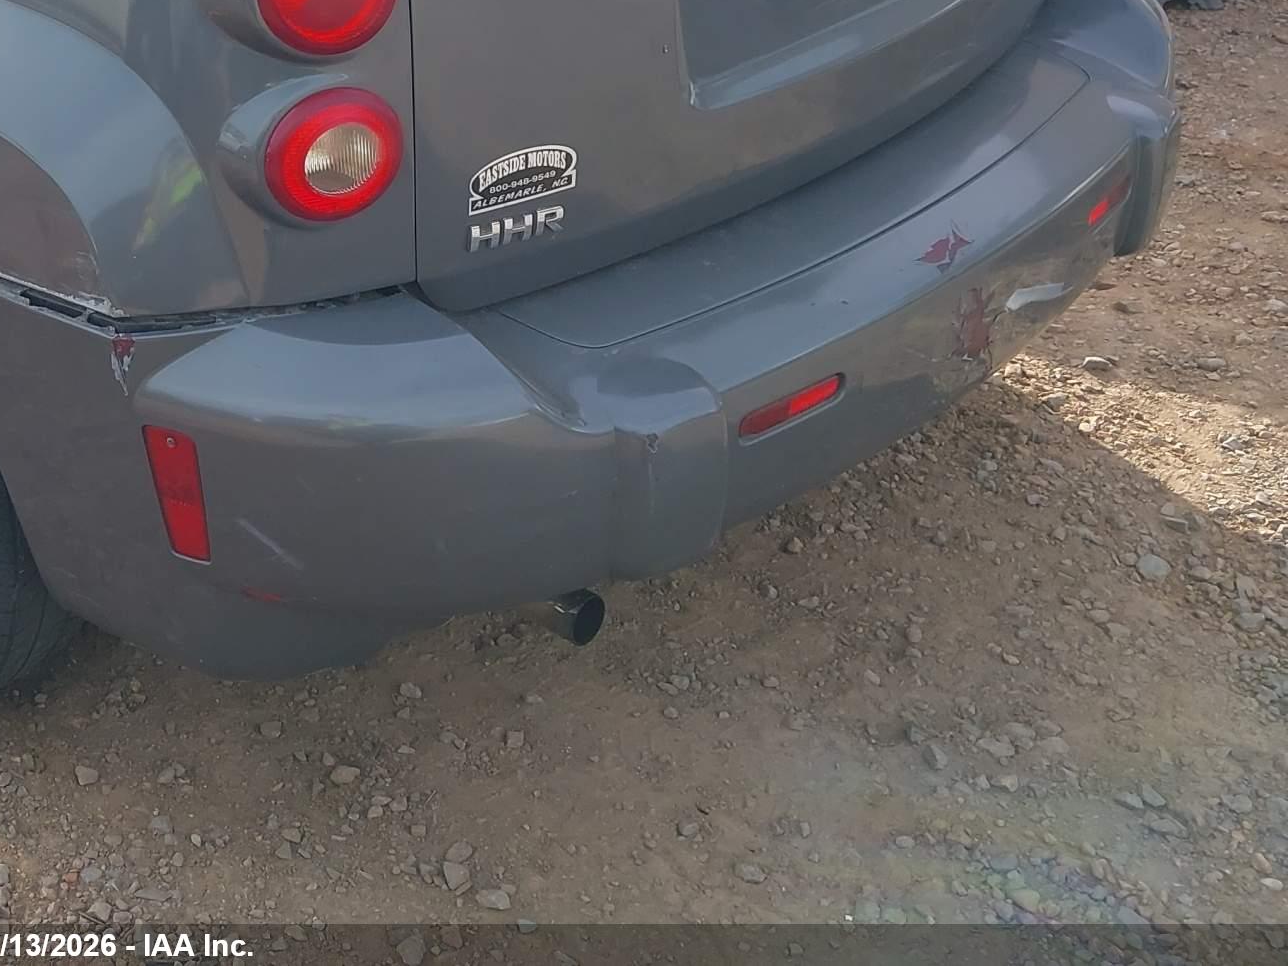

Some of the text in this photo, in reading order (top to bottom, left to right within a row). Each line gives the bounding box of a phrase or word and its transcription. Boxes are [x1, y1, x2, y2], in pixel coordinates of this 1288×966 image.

[478, 150, 567, 192] EASTSIDE MOTORS
[489, 170, 557, 194] 800-948-9549
[472, 184, 547, 209] ALBEMARLE,
[468, 205, 564, 252] HHR
